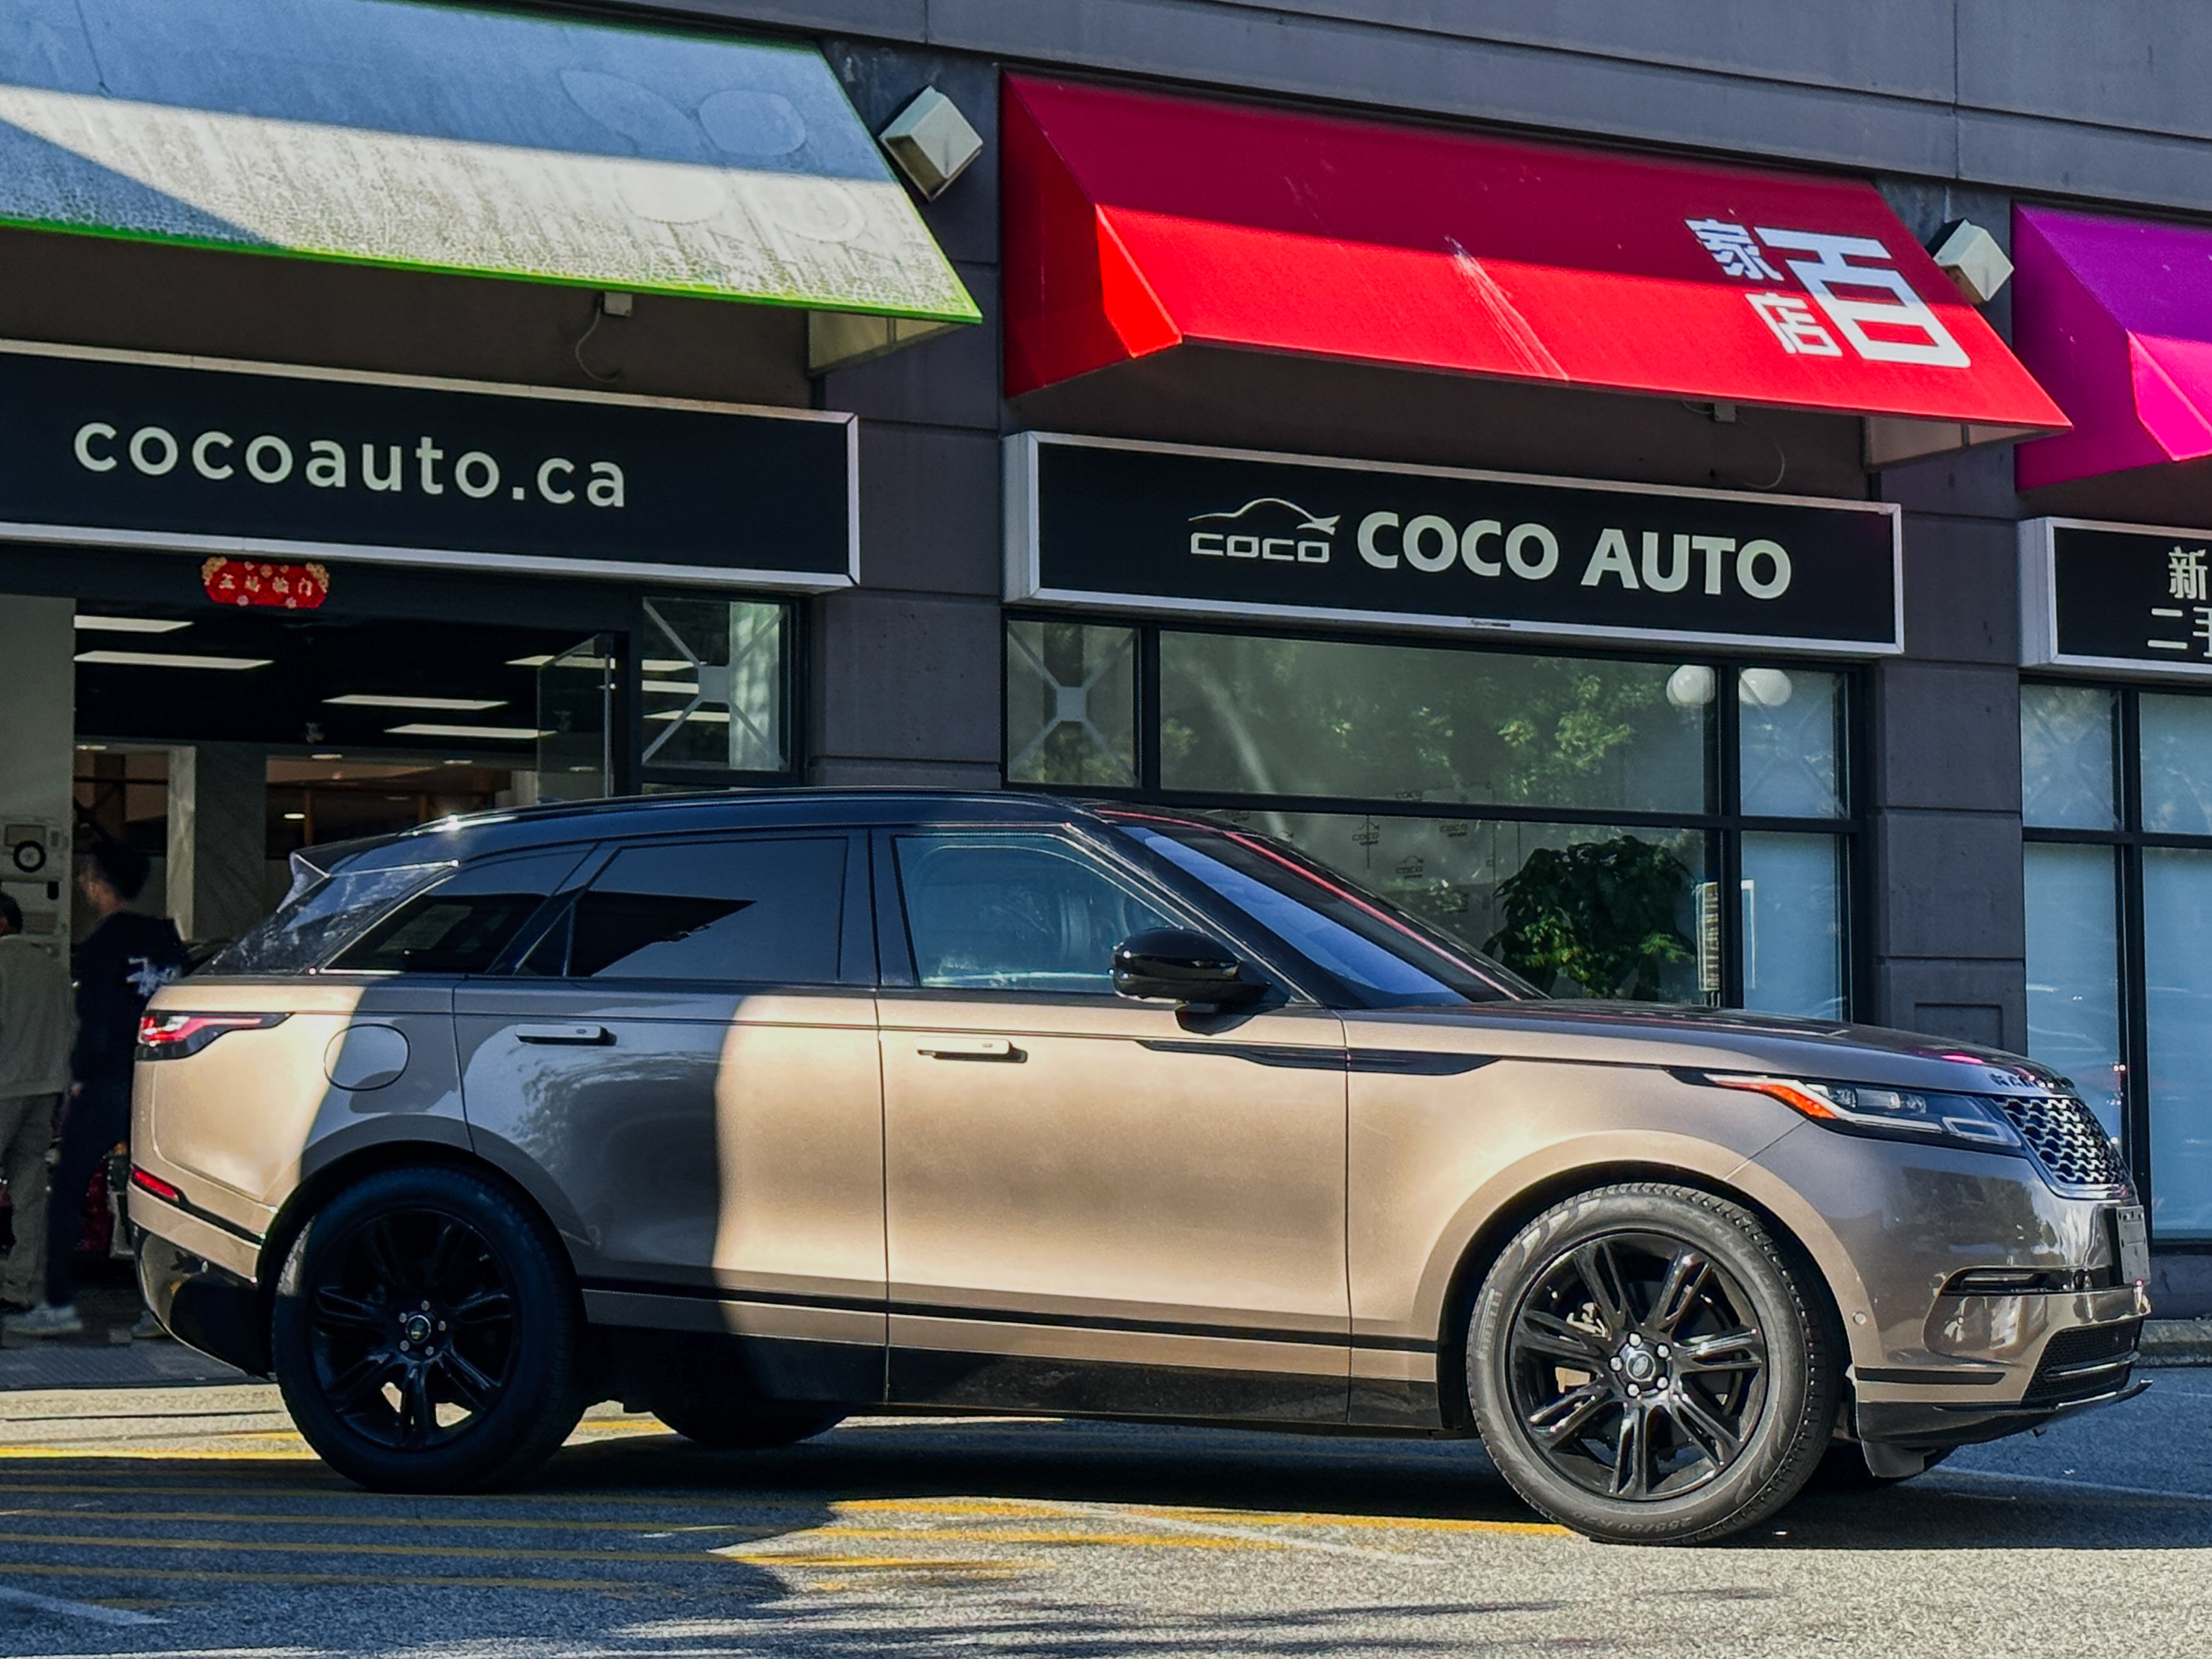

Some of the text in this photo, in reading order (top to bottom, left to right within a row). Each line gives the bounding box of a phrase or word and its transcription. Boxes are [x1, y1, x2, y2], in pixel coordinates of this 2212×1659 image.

[74, 422, 625, 508] cocoauto.ca
[1190, 532, 1331, 564] COCO
[1356, 511, 1792, 600] COCO AUTO
